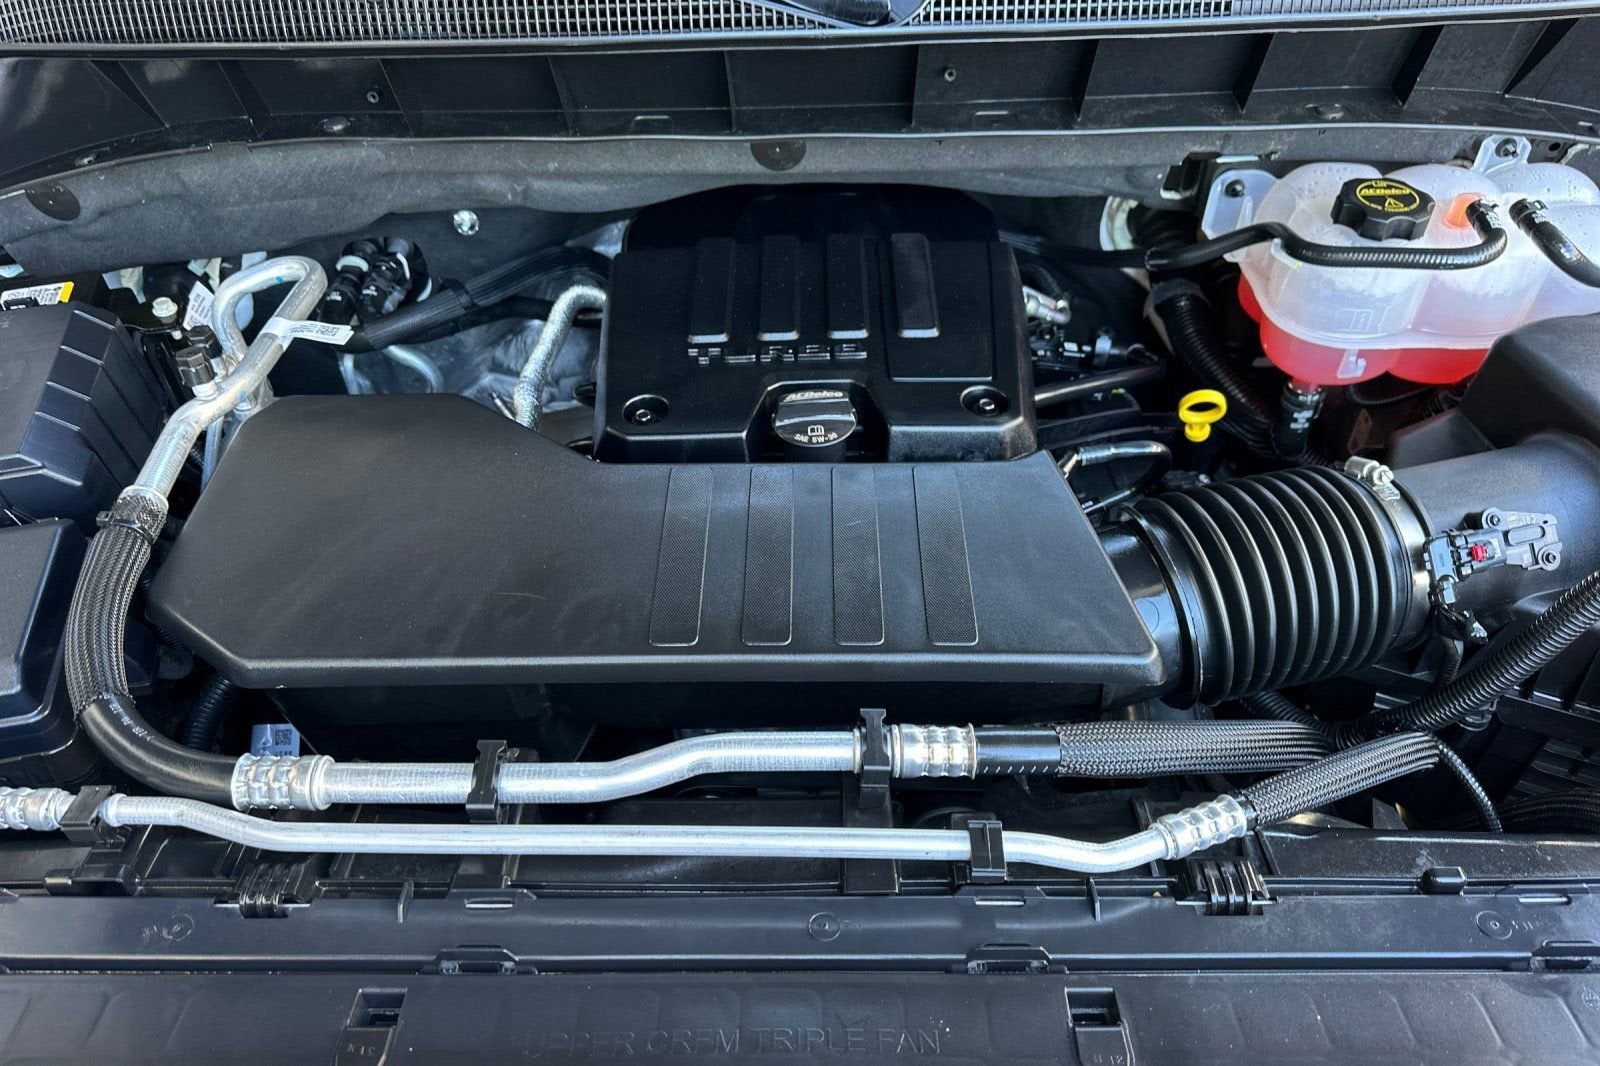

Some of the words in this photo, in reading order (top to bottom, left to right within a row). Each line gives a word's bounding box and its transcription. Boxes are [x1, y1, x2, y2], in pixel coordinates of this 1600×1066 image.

[782, 390, 844, 403] ACDelco
[793, 432, 810, 443] SAE
[521, 1031, 635, 1058] UPPER
[750, 1027, 866, 1054] TRIPLE
[876, 1028, 941, 1055] FAN
